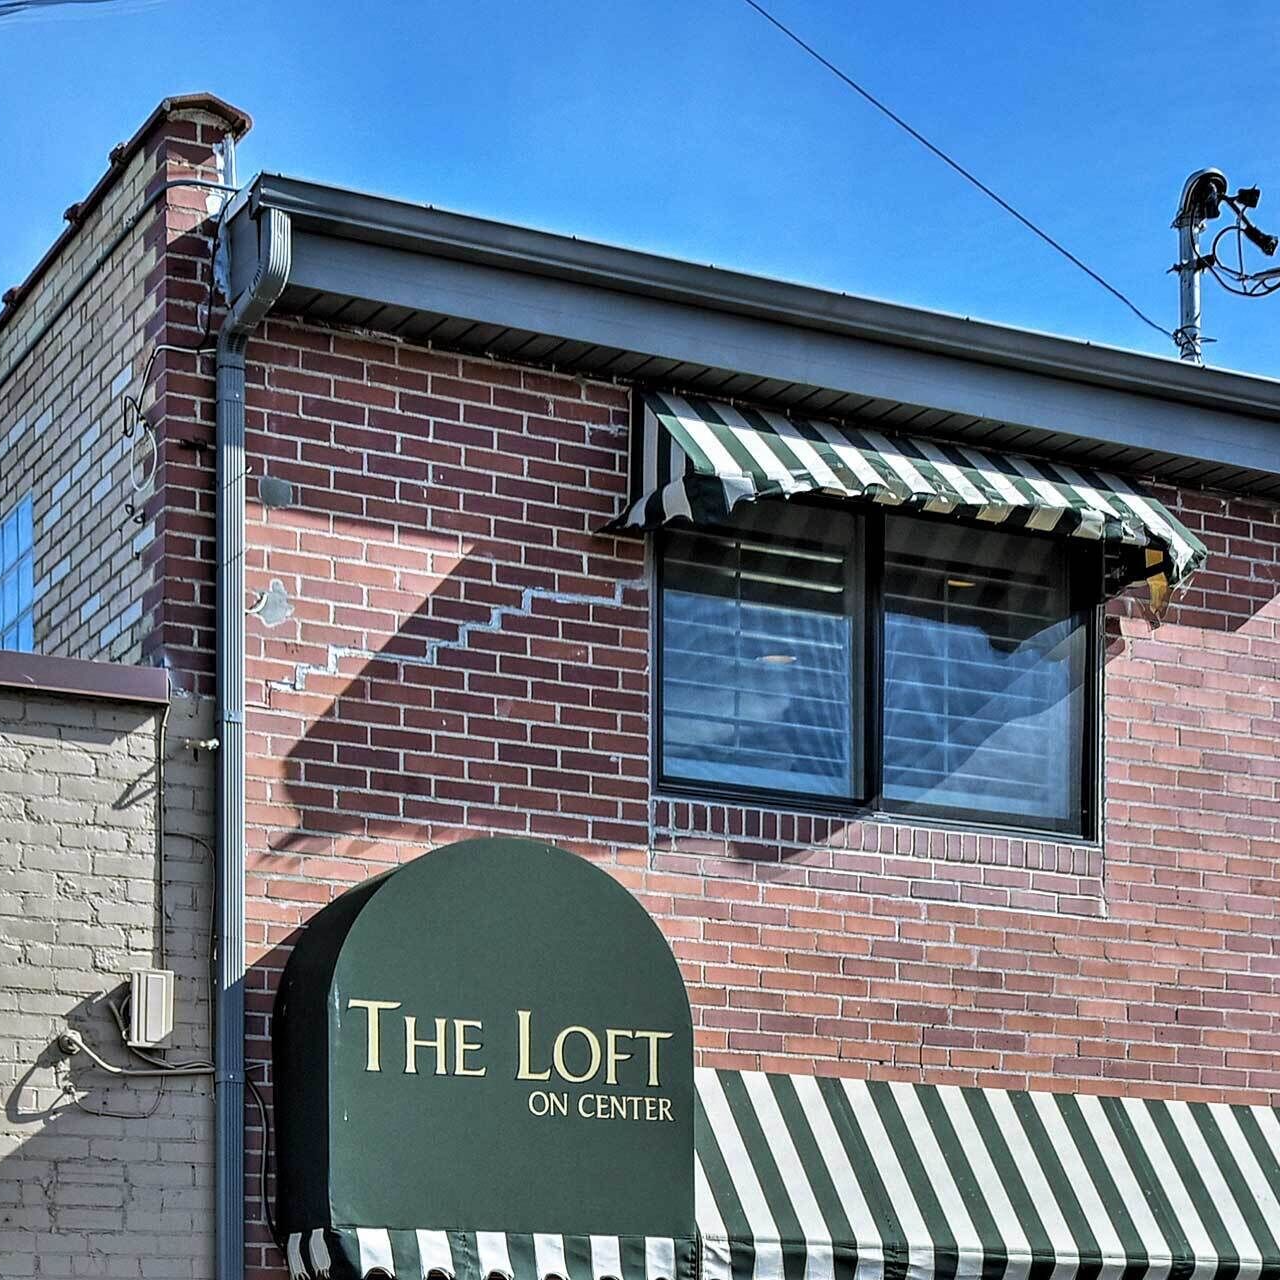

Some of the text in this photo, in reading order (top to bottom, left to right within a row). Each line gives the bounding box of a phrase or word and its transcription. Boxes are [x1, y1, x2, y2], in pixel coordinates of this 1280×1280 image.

[348, 998, 674, 1087] THE LOFT
[528, 1091, 675, 1122] ON CENTER
